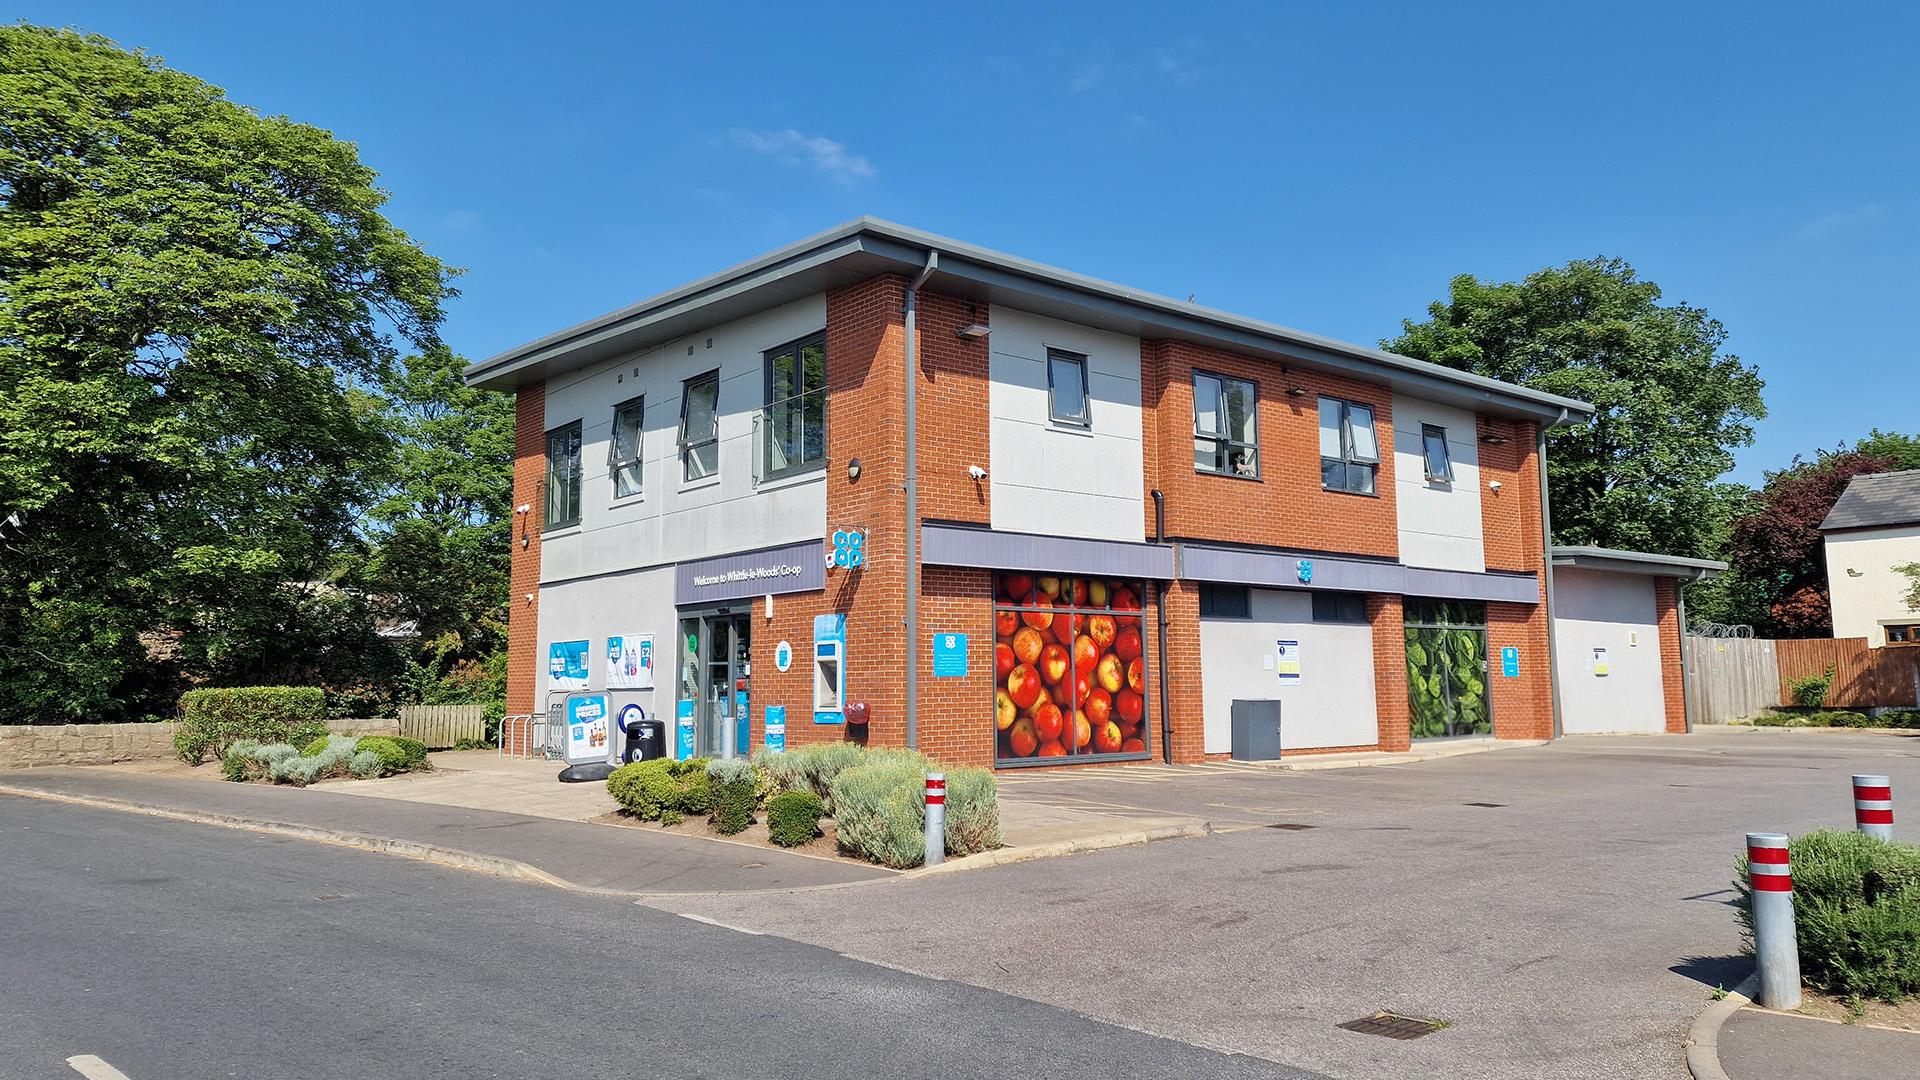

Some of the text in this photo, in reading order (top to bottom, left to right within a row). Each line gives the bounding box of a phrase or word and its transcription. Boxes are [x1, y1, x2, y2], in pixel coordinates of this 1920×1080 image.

[693, 575, 720, 587] Welcome
[719, 574, 727, 583] to
[780, 564, 802, 577] Co-op
[641, 647, 650, 658] £2
[576, 708, 602, 719] PRICES
